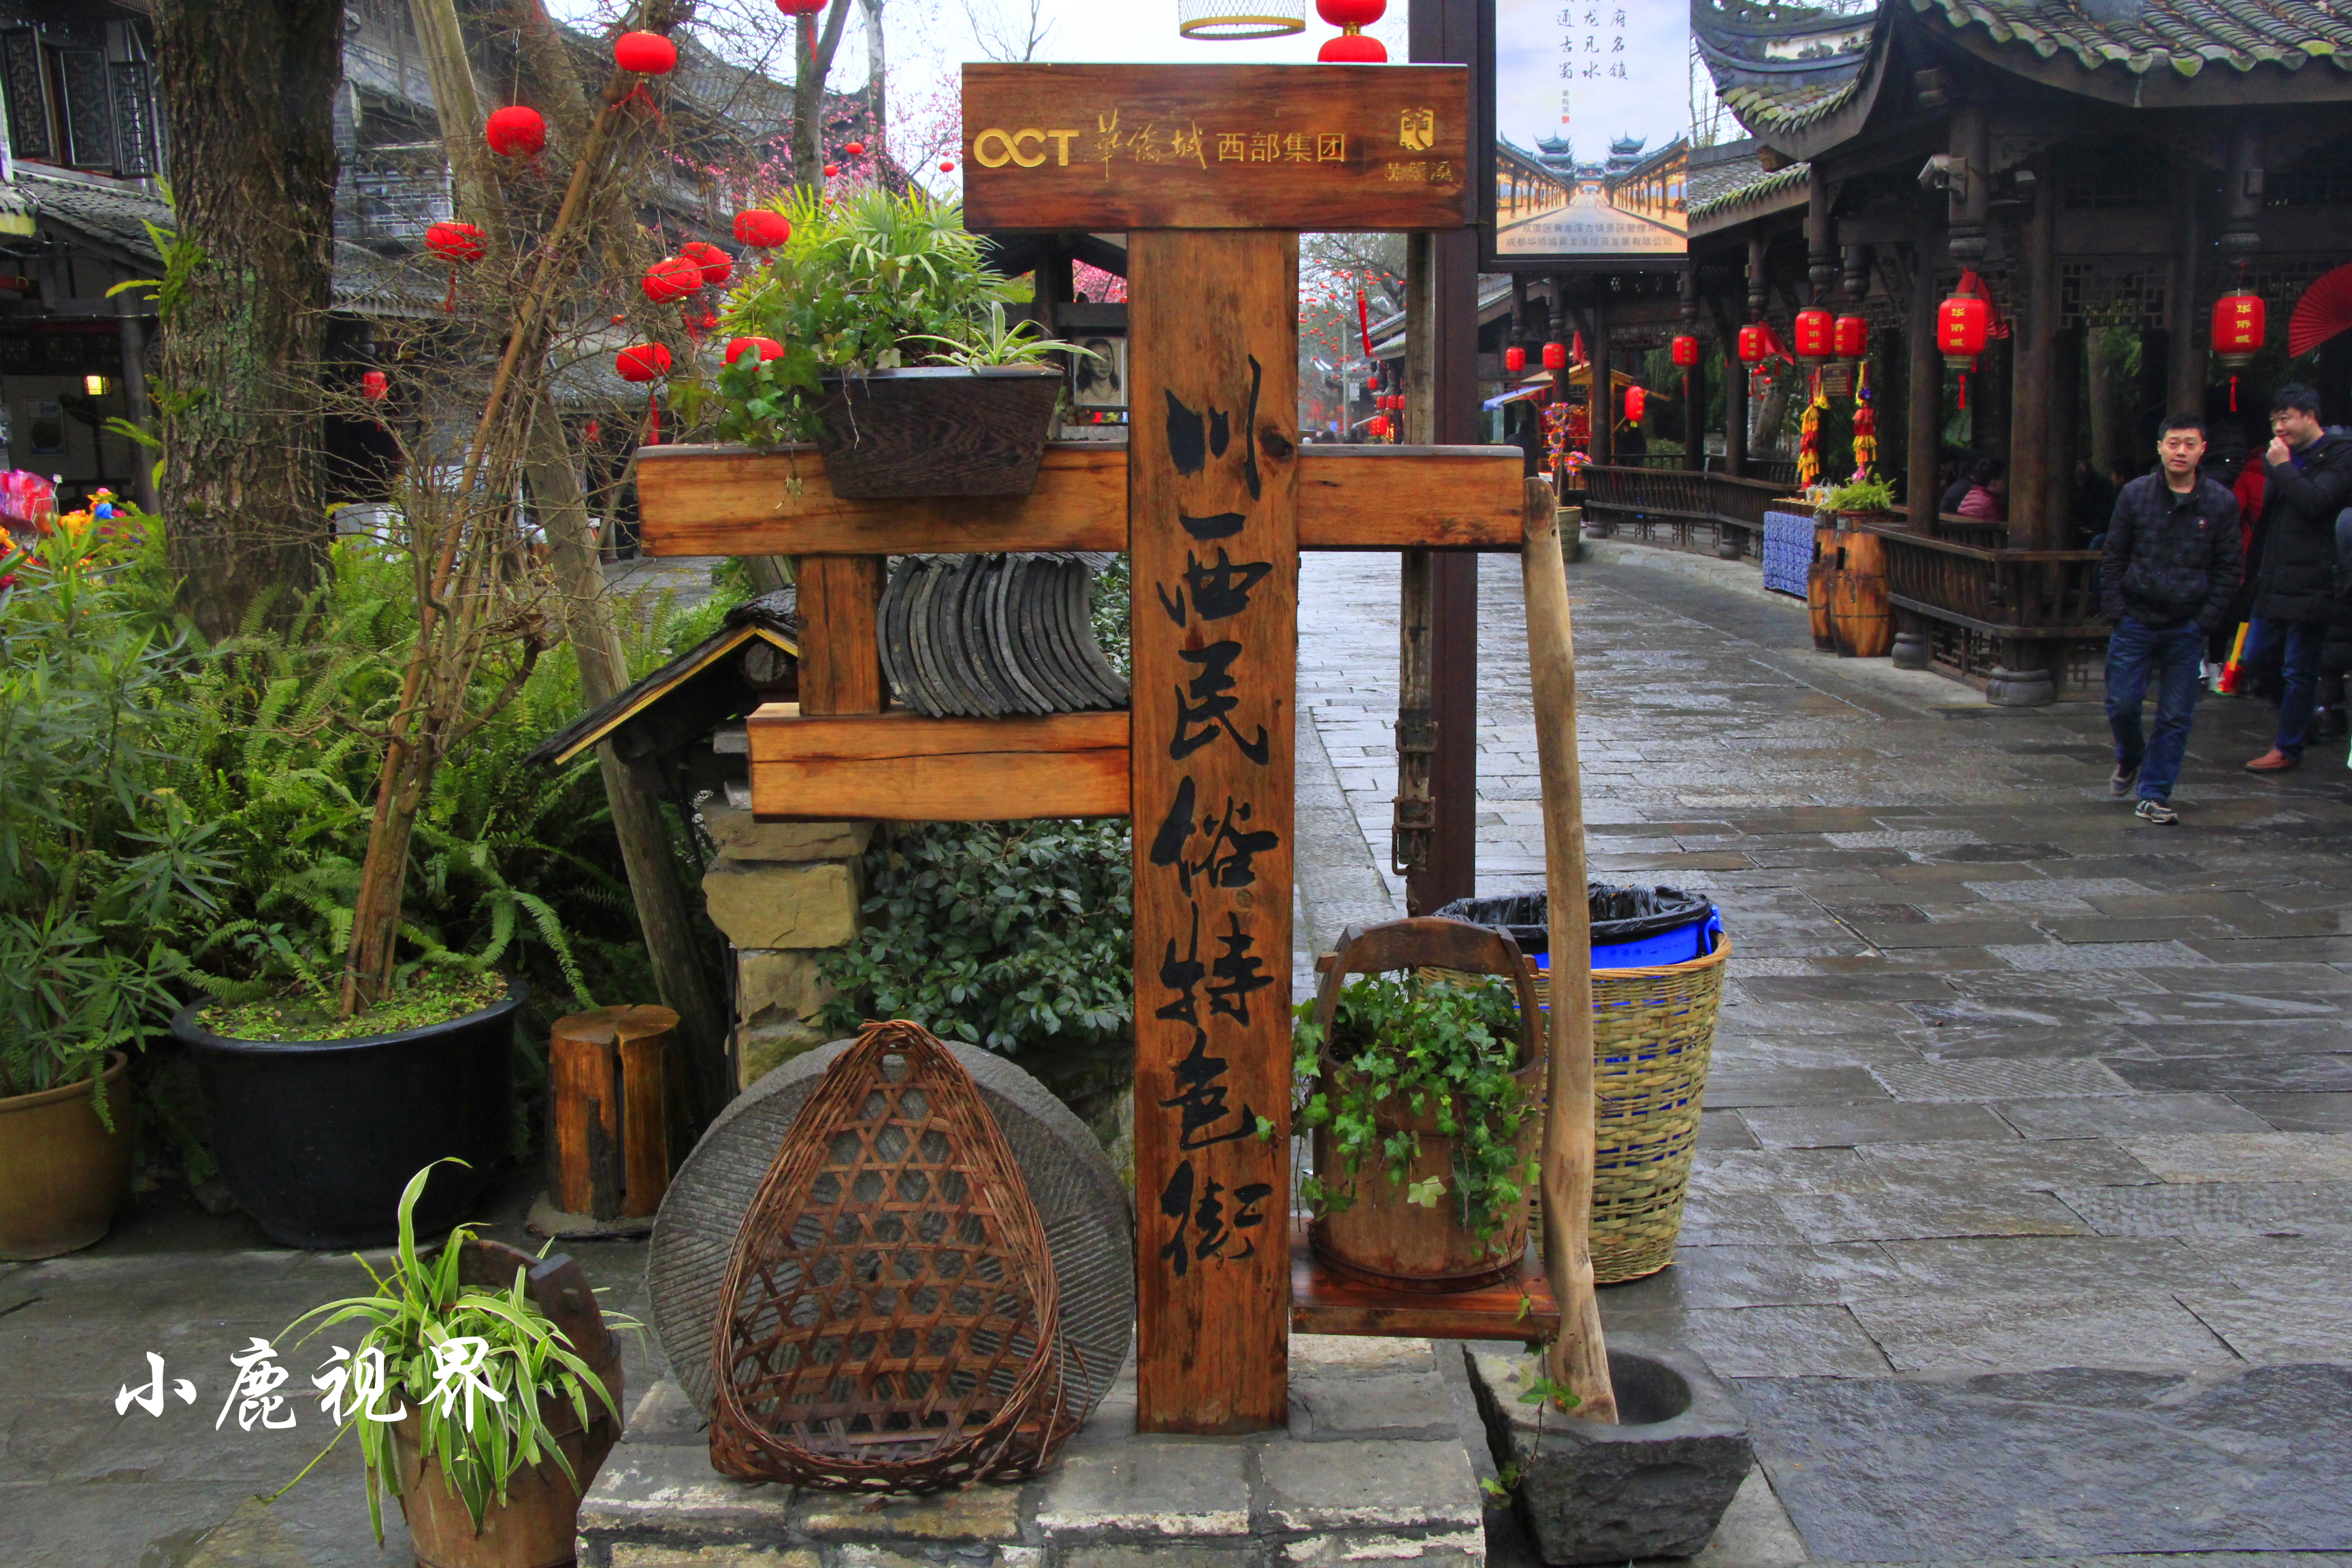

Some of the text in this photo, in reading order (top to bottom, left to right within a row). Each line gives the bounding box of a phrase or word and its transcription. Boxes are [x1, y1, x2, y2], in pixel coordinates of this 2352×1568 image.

[1556, 0, 1575, 79] 通古蜀
[1607, 0, 1628, 80] 府名镇
[973, 128, 1079, 168] OCT
[1216, 131, 1346, 163] 西部集团
[1156, 353, 1279, 1277] 川西民俗特色街
